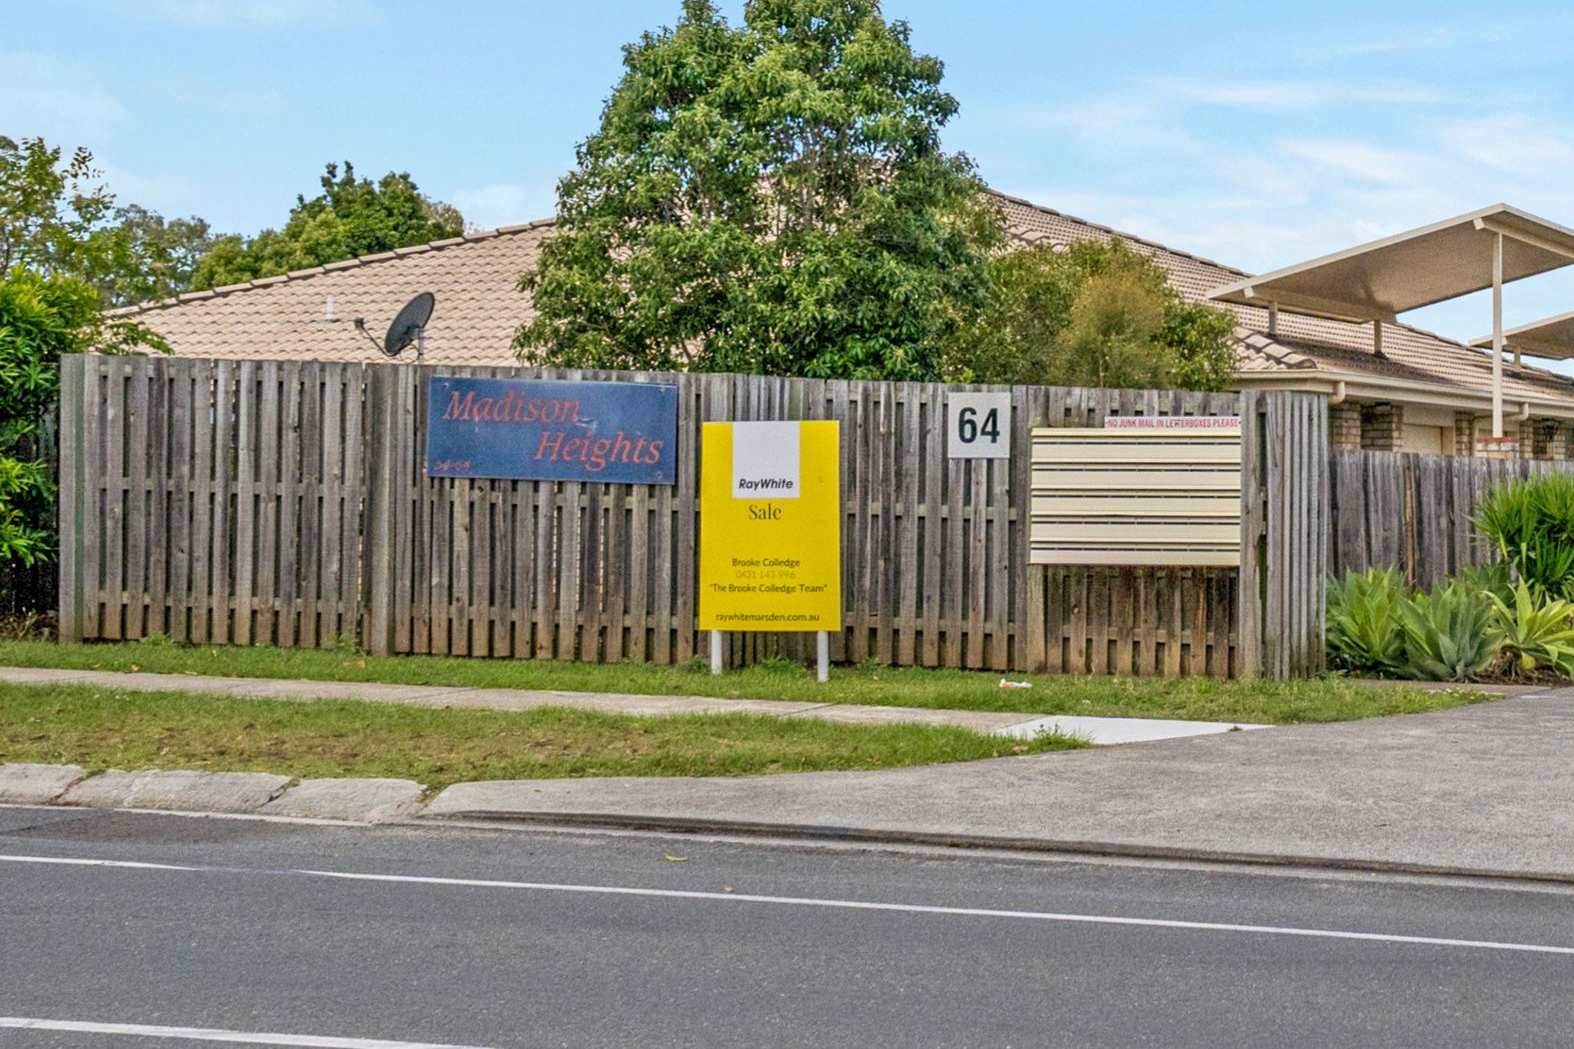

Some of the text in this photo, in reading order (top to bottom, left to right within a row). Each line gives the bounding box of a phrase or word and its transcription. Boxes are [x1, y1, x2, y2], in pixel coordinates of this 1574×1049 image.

[442, 390, 580, 423] Madison
[959, 407, 1000, 444] 64
[1108, 419, 1239, 428] NO JUNK MAIL IN LETTERBOXES PLEASE
[534, 431, 664, 471] Heights
[748, 504, 782, 521] Sale
[732, 558, 800, 568] Brooke Colledge
[728, 583, 757, 593] Brooke
[759, 583, 797, 594] Colledge
[715, 613, 820, 622] raywhitemarsden.com.au
